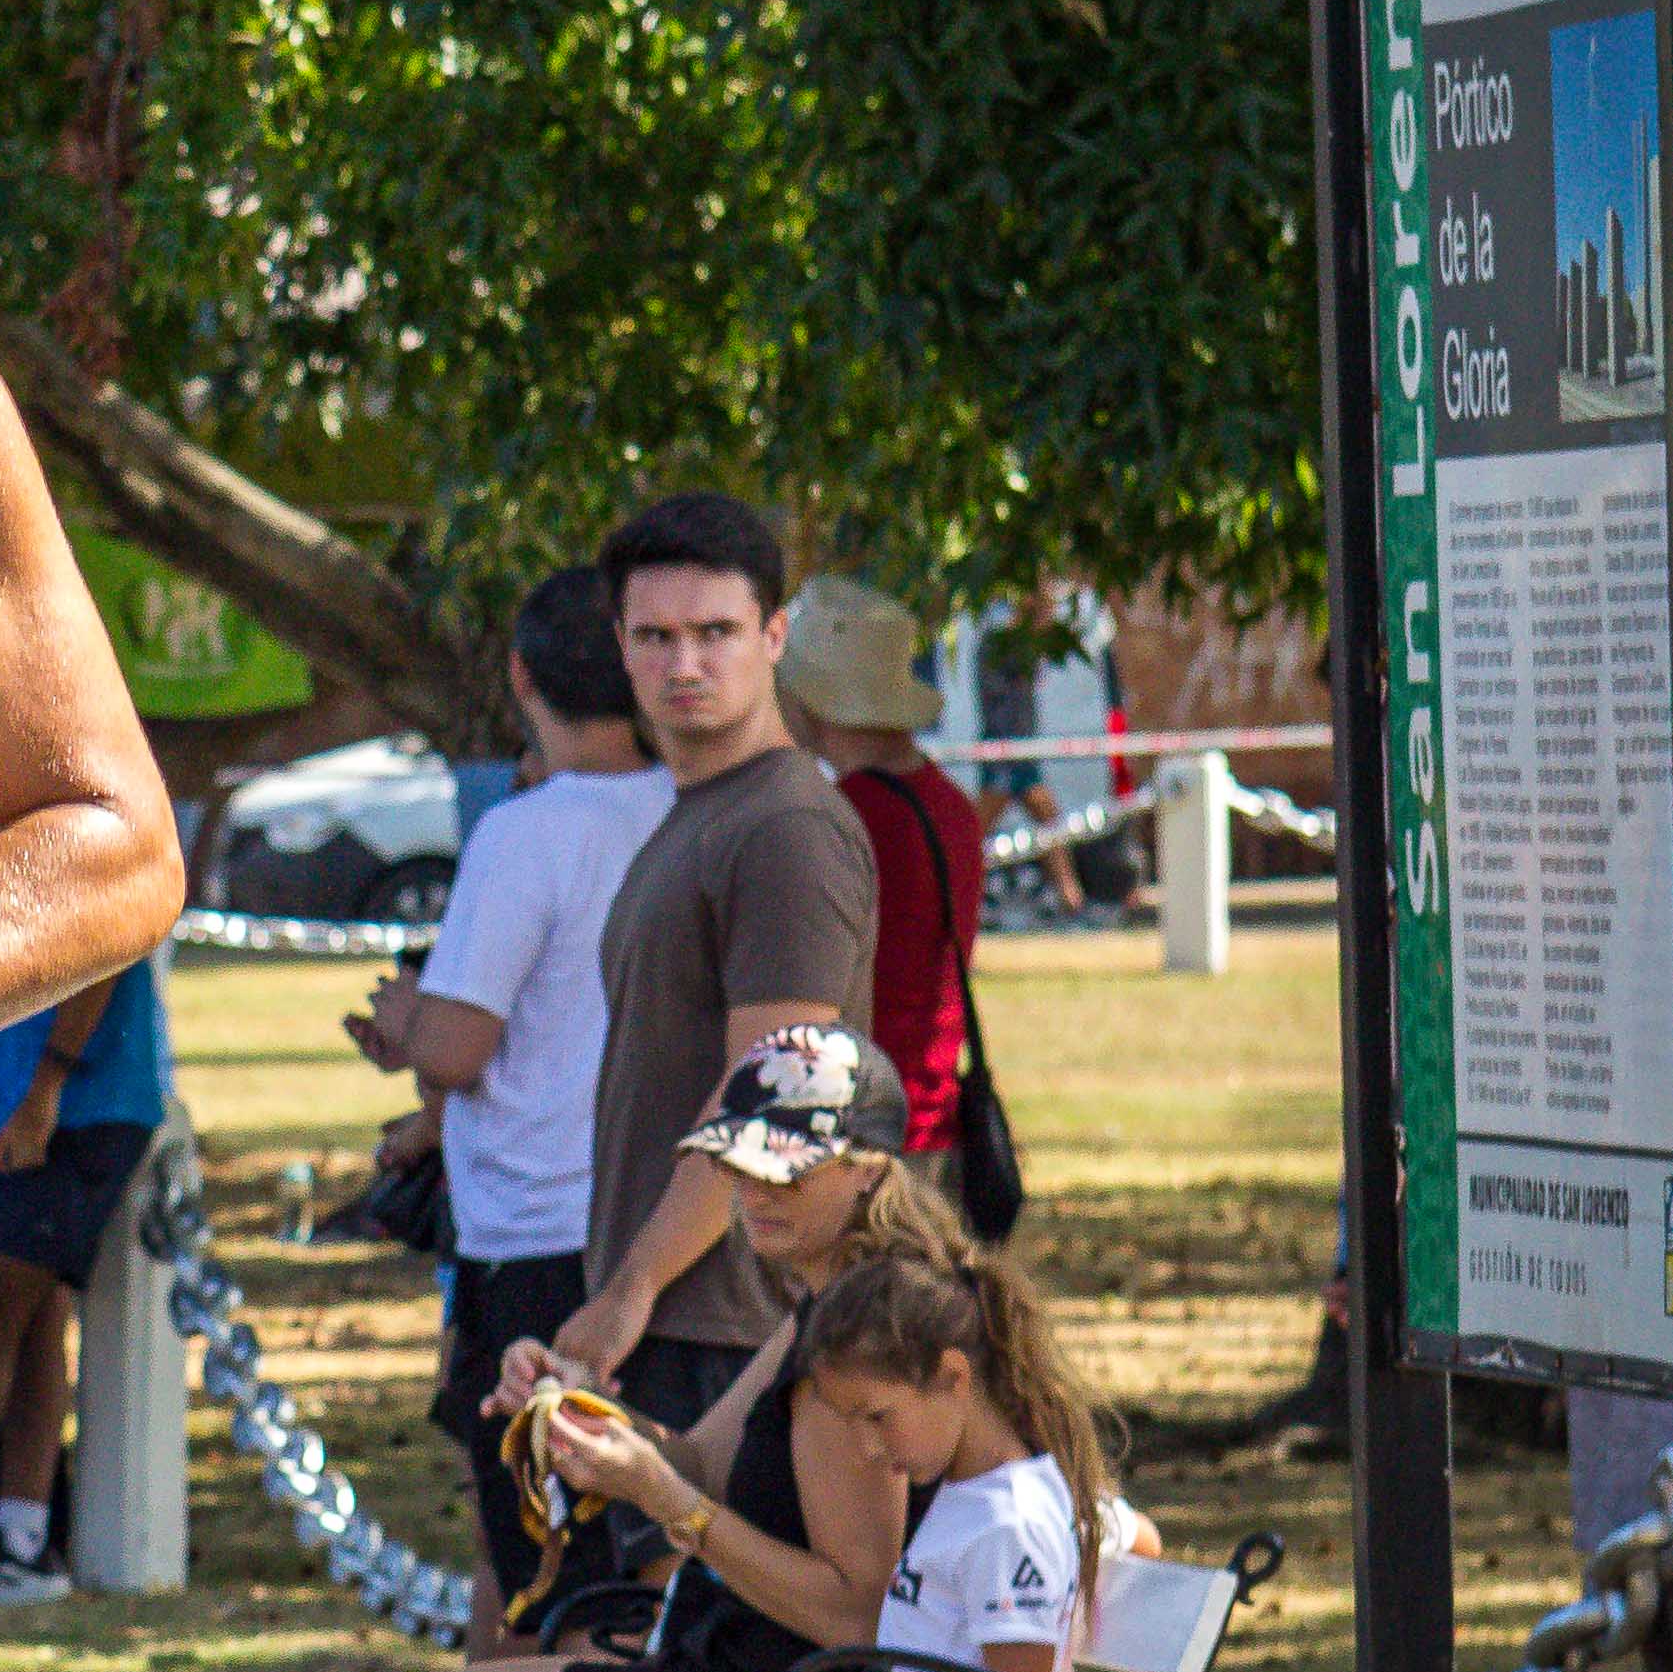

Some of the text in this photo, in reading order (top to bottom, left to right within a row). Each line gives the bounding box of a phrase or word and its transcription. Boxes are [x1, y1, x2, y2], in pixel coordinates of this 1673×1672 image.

[1433, 55, 1514, 151] Pórtico
[1439, 190, 1495, 287] de la
[1442, 322, 1512, 424] Gloria
[1404, 580, 1441, 916] San
[1469, 1174, 1546, 1218] MUNICIPALIDAD
